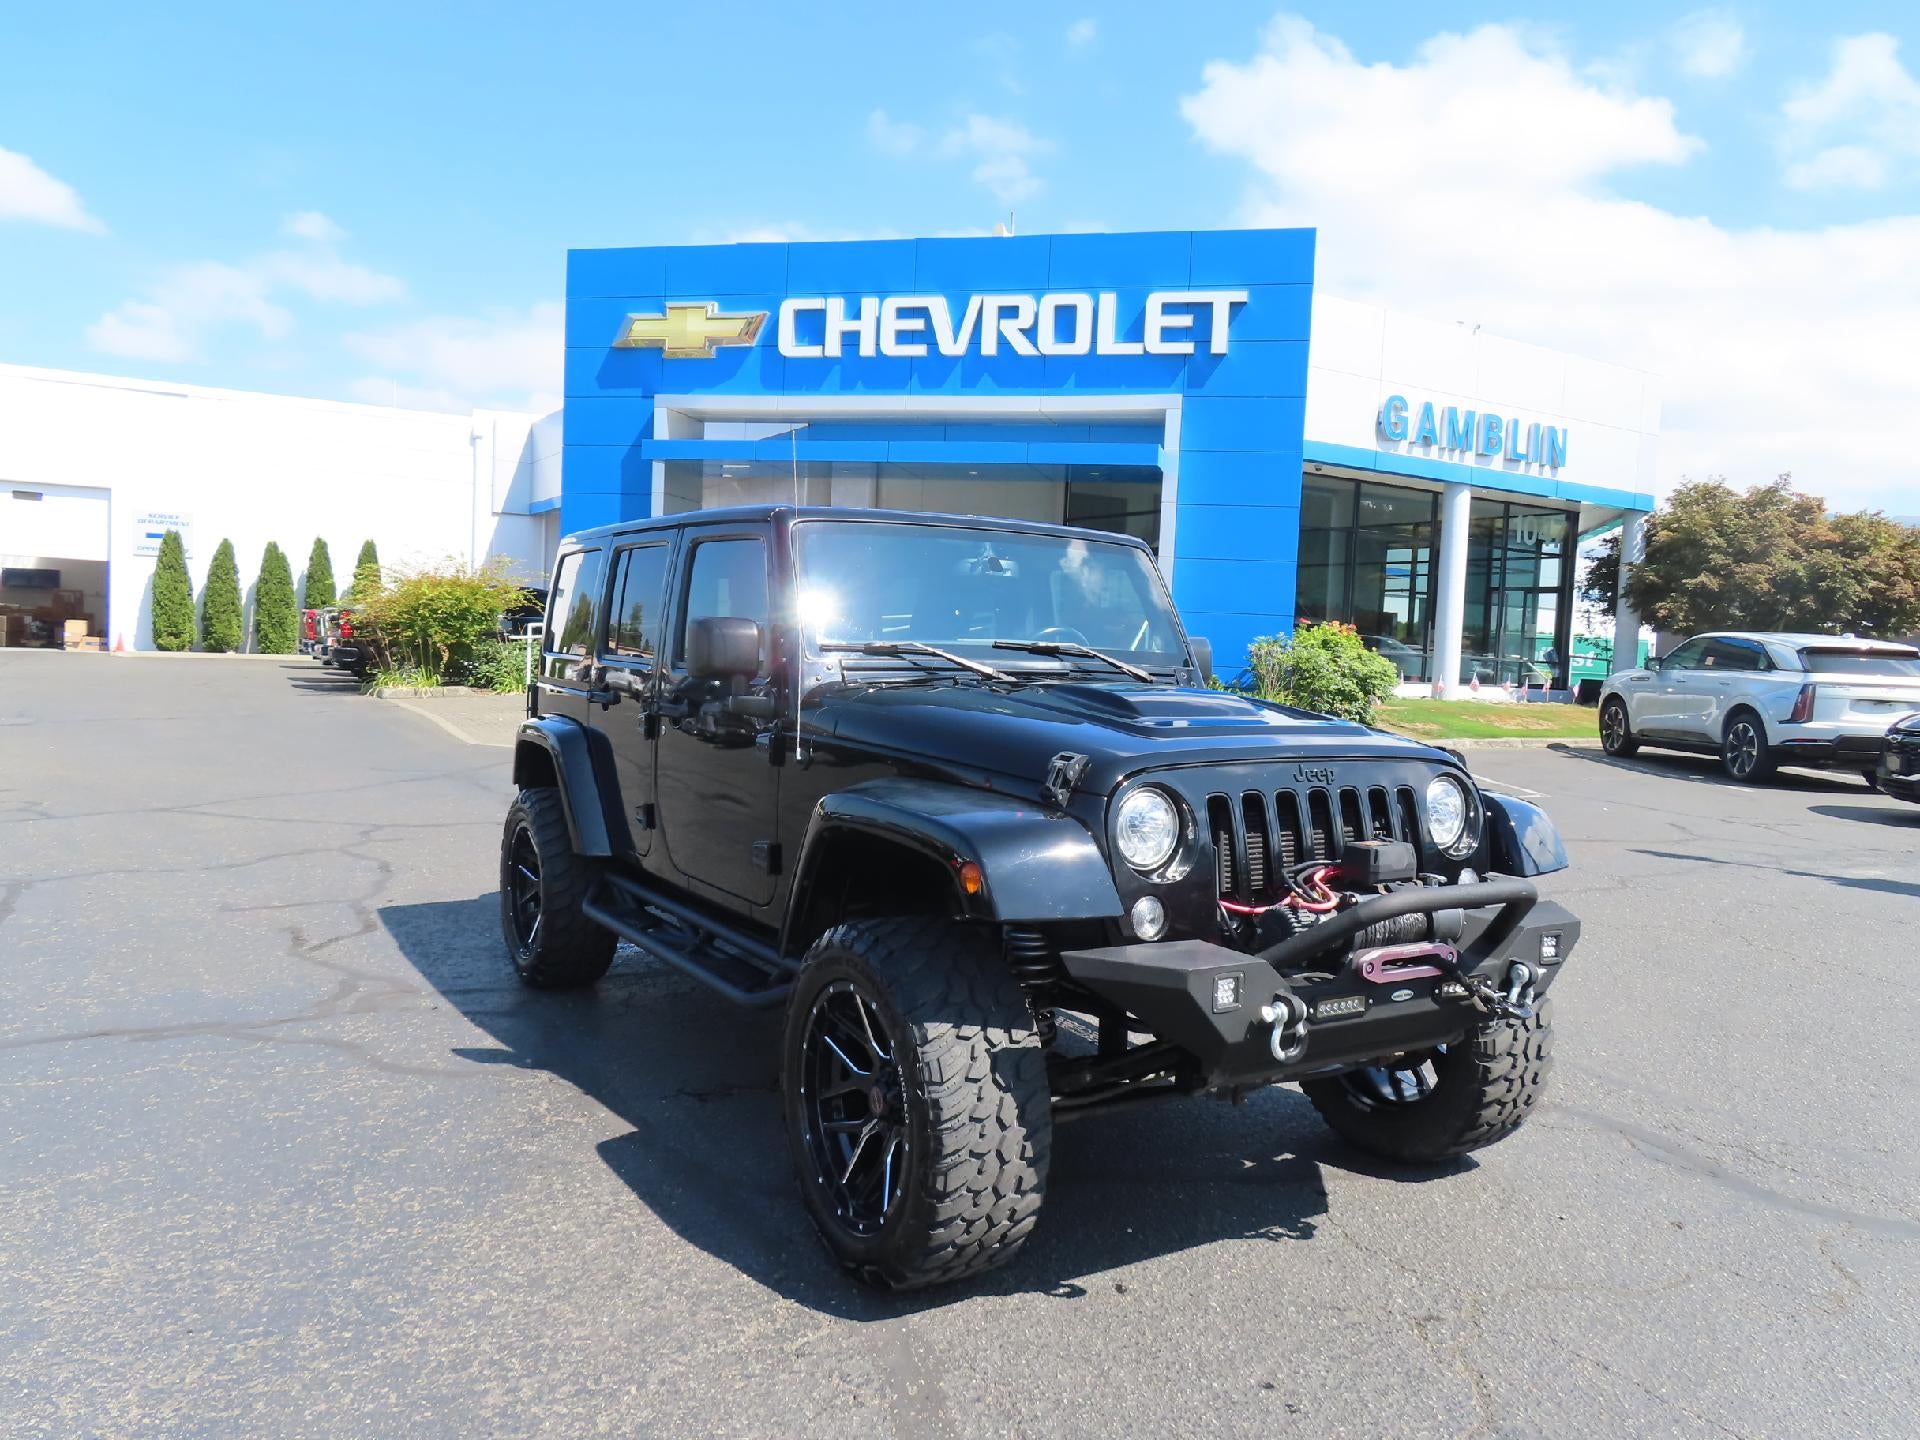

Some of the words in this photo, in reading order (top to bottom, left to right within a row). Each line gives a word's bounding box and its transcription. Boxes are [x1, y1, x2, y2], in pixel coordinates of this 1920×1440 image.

[778, 291, 1248, 357] CHEVROLET
[1376, 394, 1568, 468] GAMBLIN
[1292, 763, 1336, 785] Jeep
